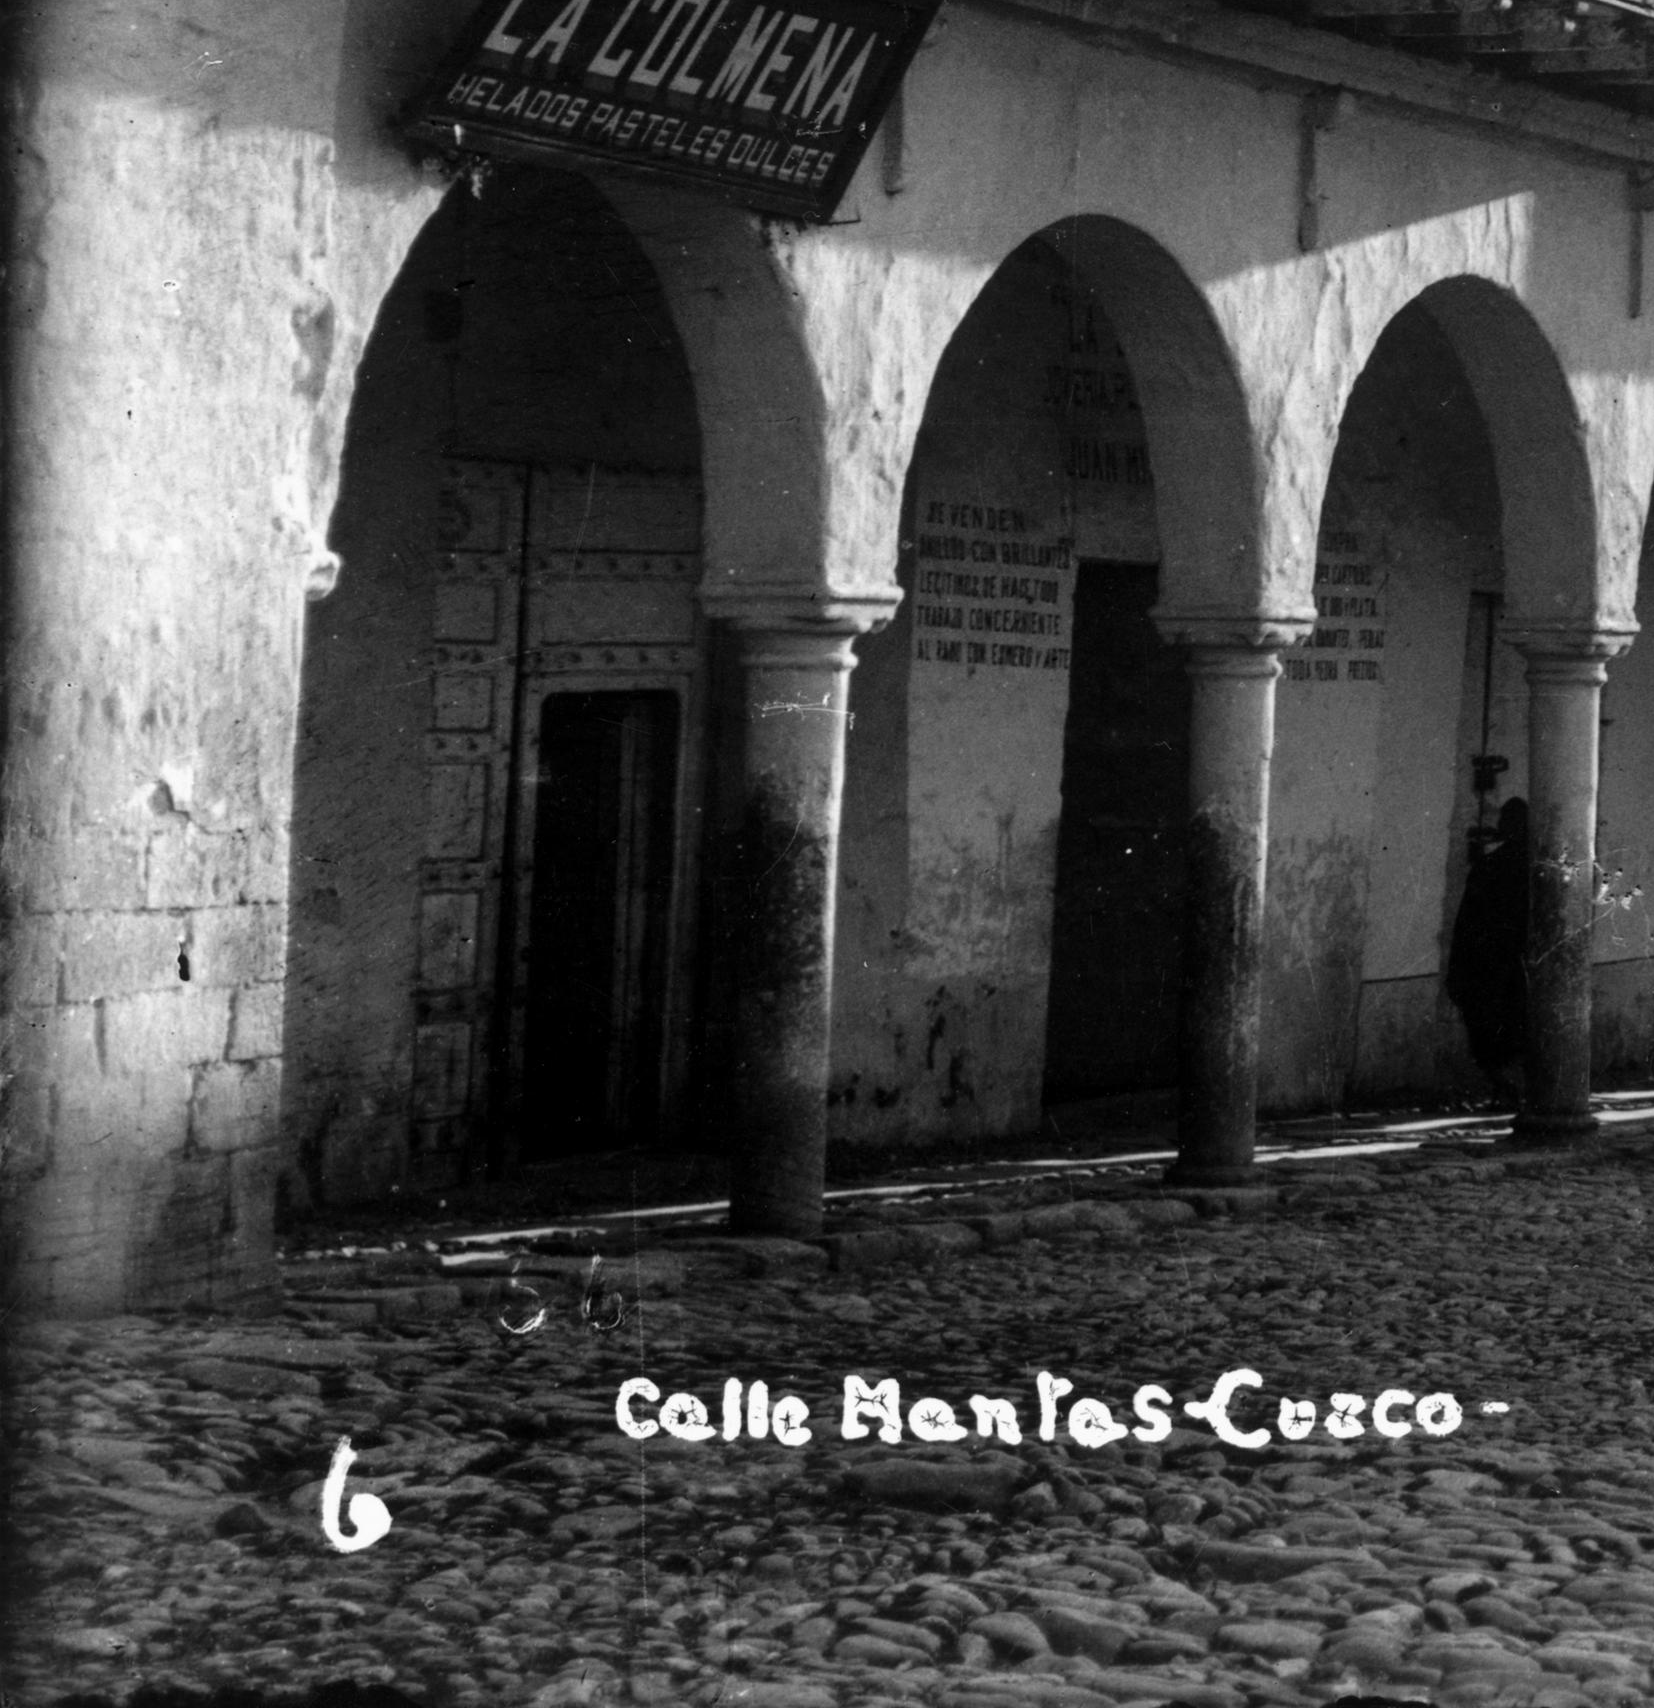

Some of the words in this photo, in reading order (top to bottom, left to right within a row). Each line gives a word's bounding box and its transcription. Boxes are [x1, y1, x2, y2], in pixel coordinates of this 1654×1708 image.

[446, 73, 589, 128] HELADOS
[585, 102, 729, 160] PASTELES
[726, 134, 836, 182] DULCES
[949, 503, 1027, 533] VENDEN
[916, 639, 931, 662] AL
